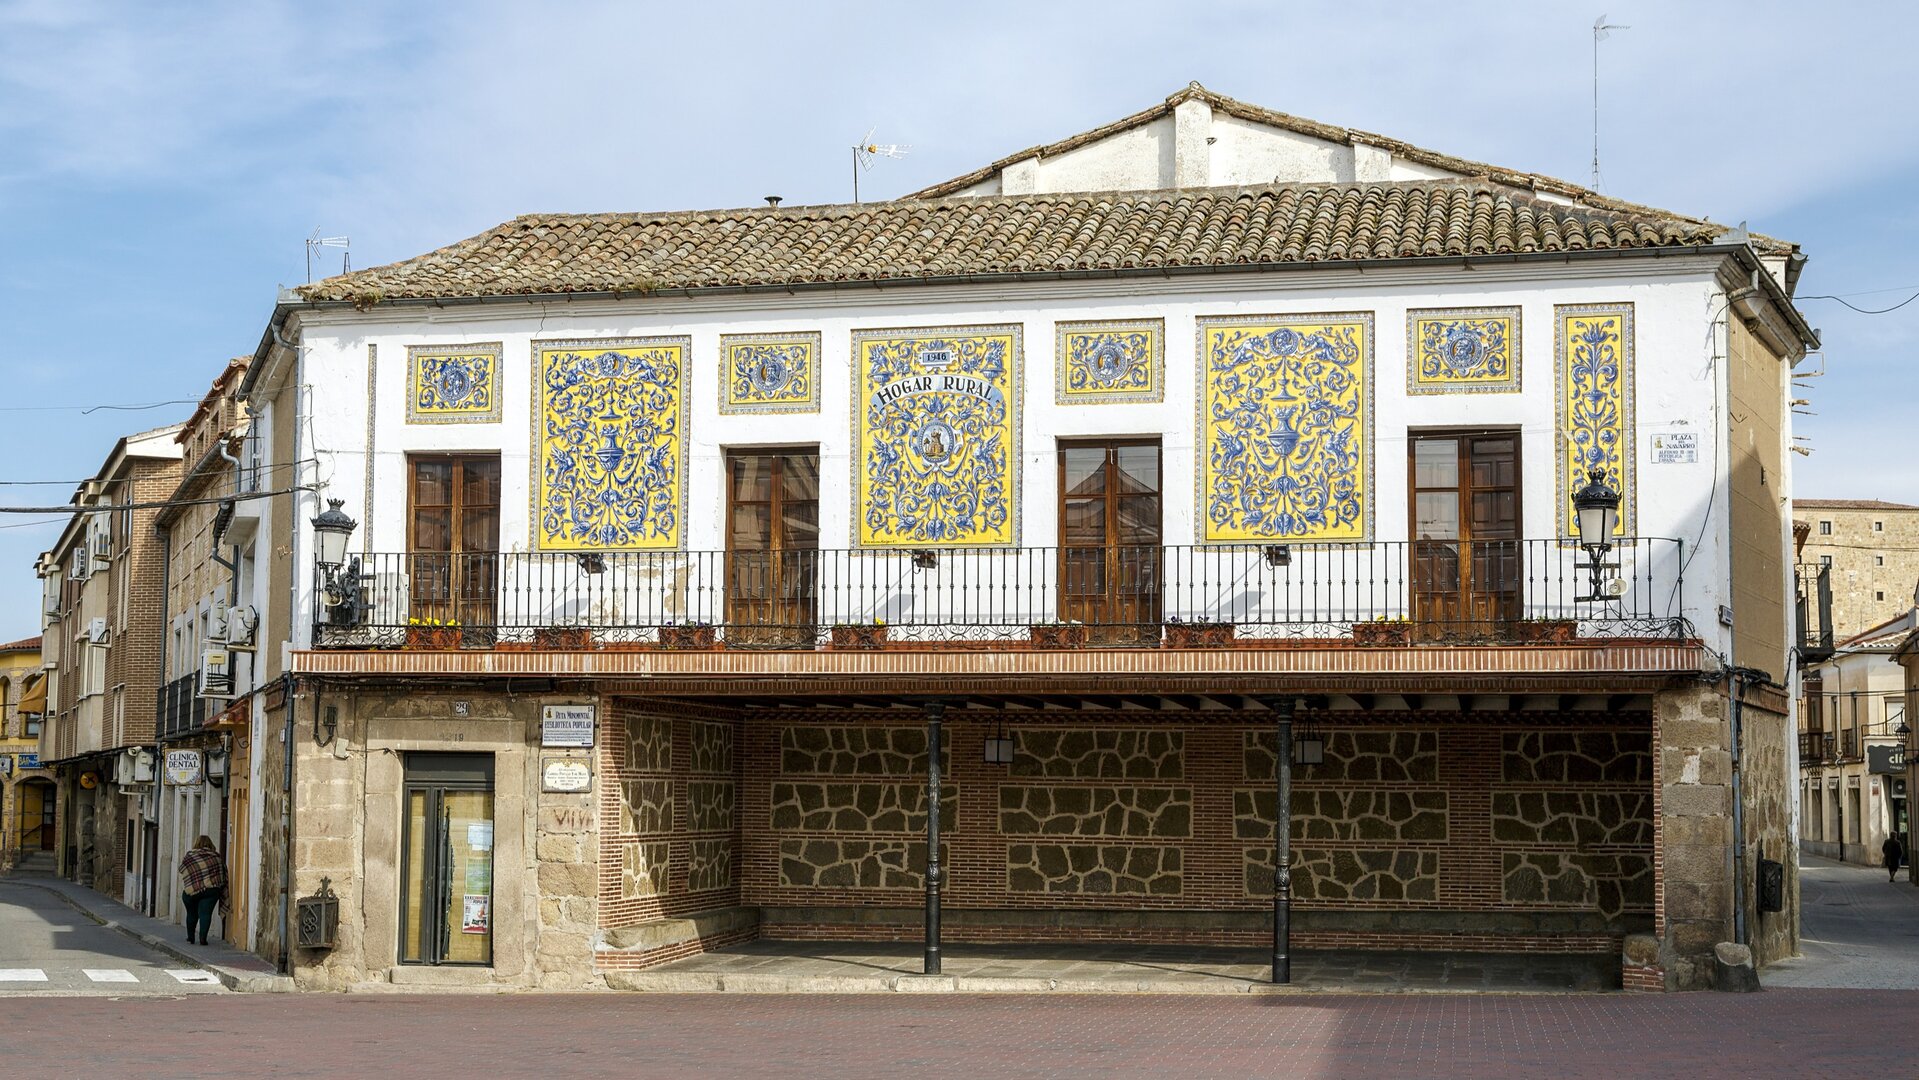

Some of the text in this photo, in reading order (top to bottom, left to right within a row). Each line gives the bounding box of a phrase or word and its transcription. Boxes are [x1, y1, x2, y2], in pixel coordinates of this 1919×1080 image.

[927, 353, 947, 361] 1946
[877, 376, 993, 405] HOGAR RURAL
[456, 702, 468, 714] 29
[168, 760, 199, 768] DENTAL
[1888, 753, 1906, 764] clí
